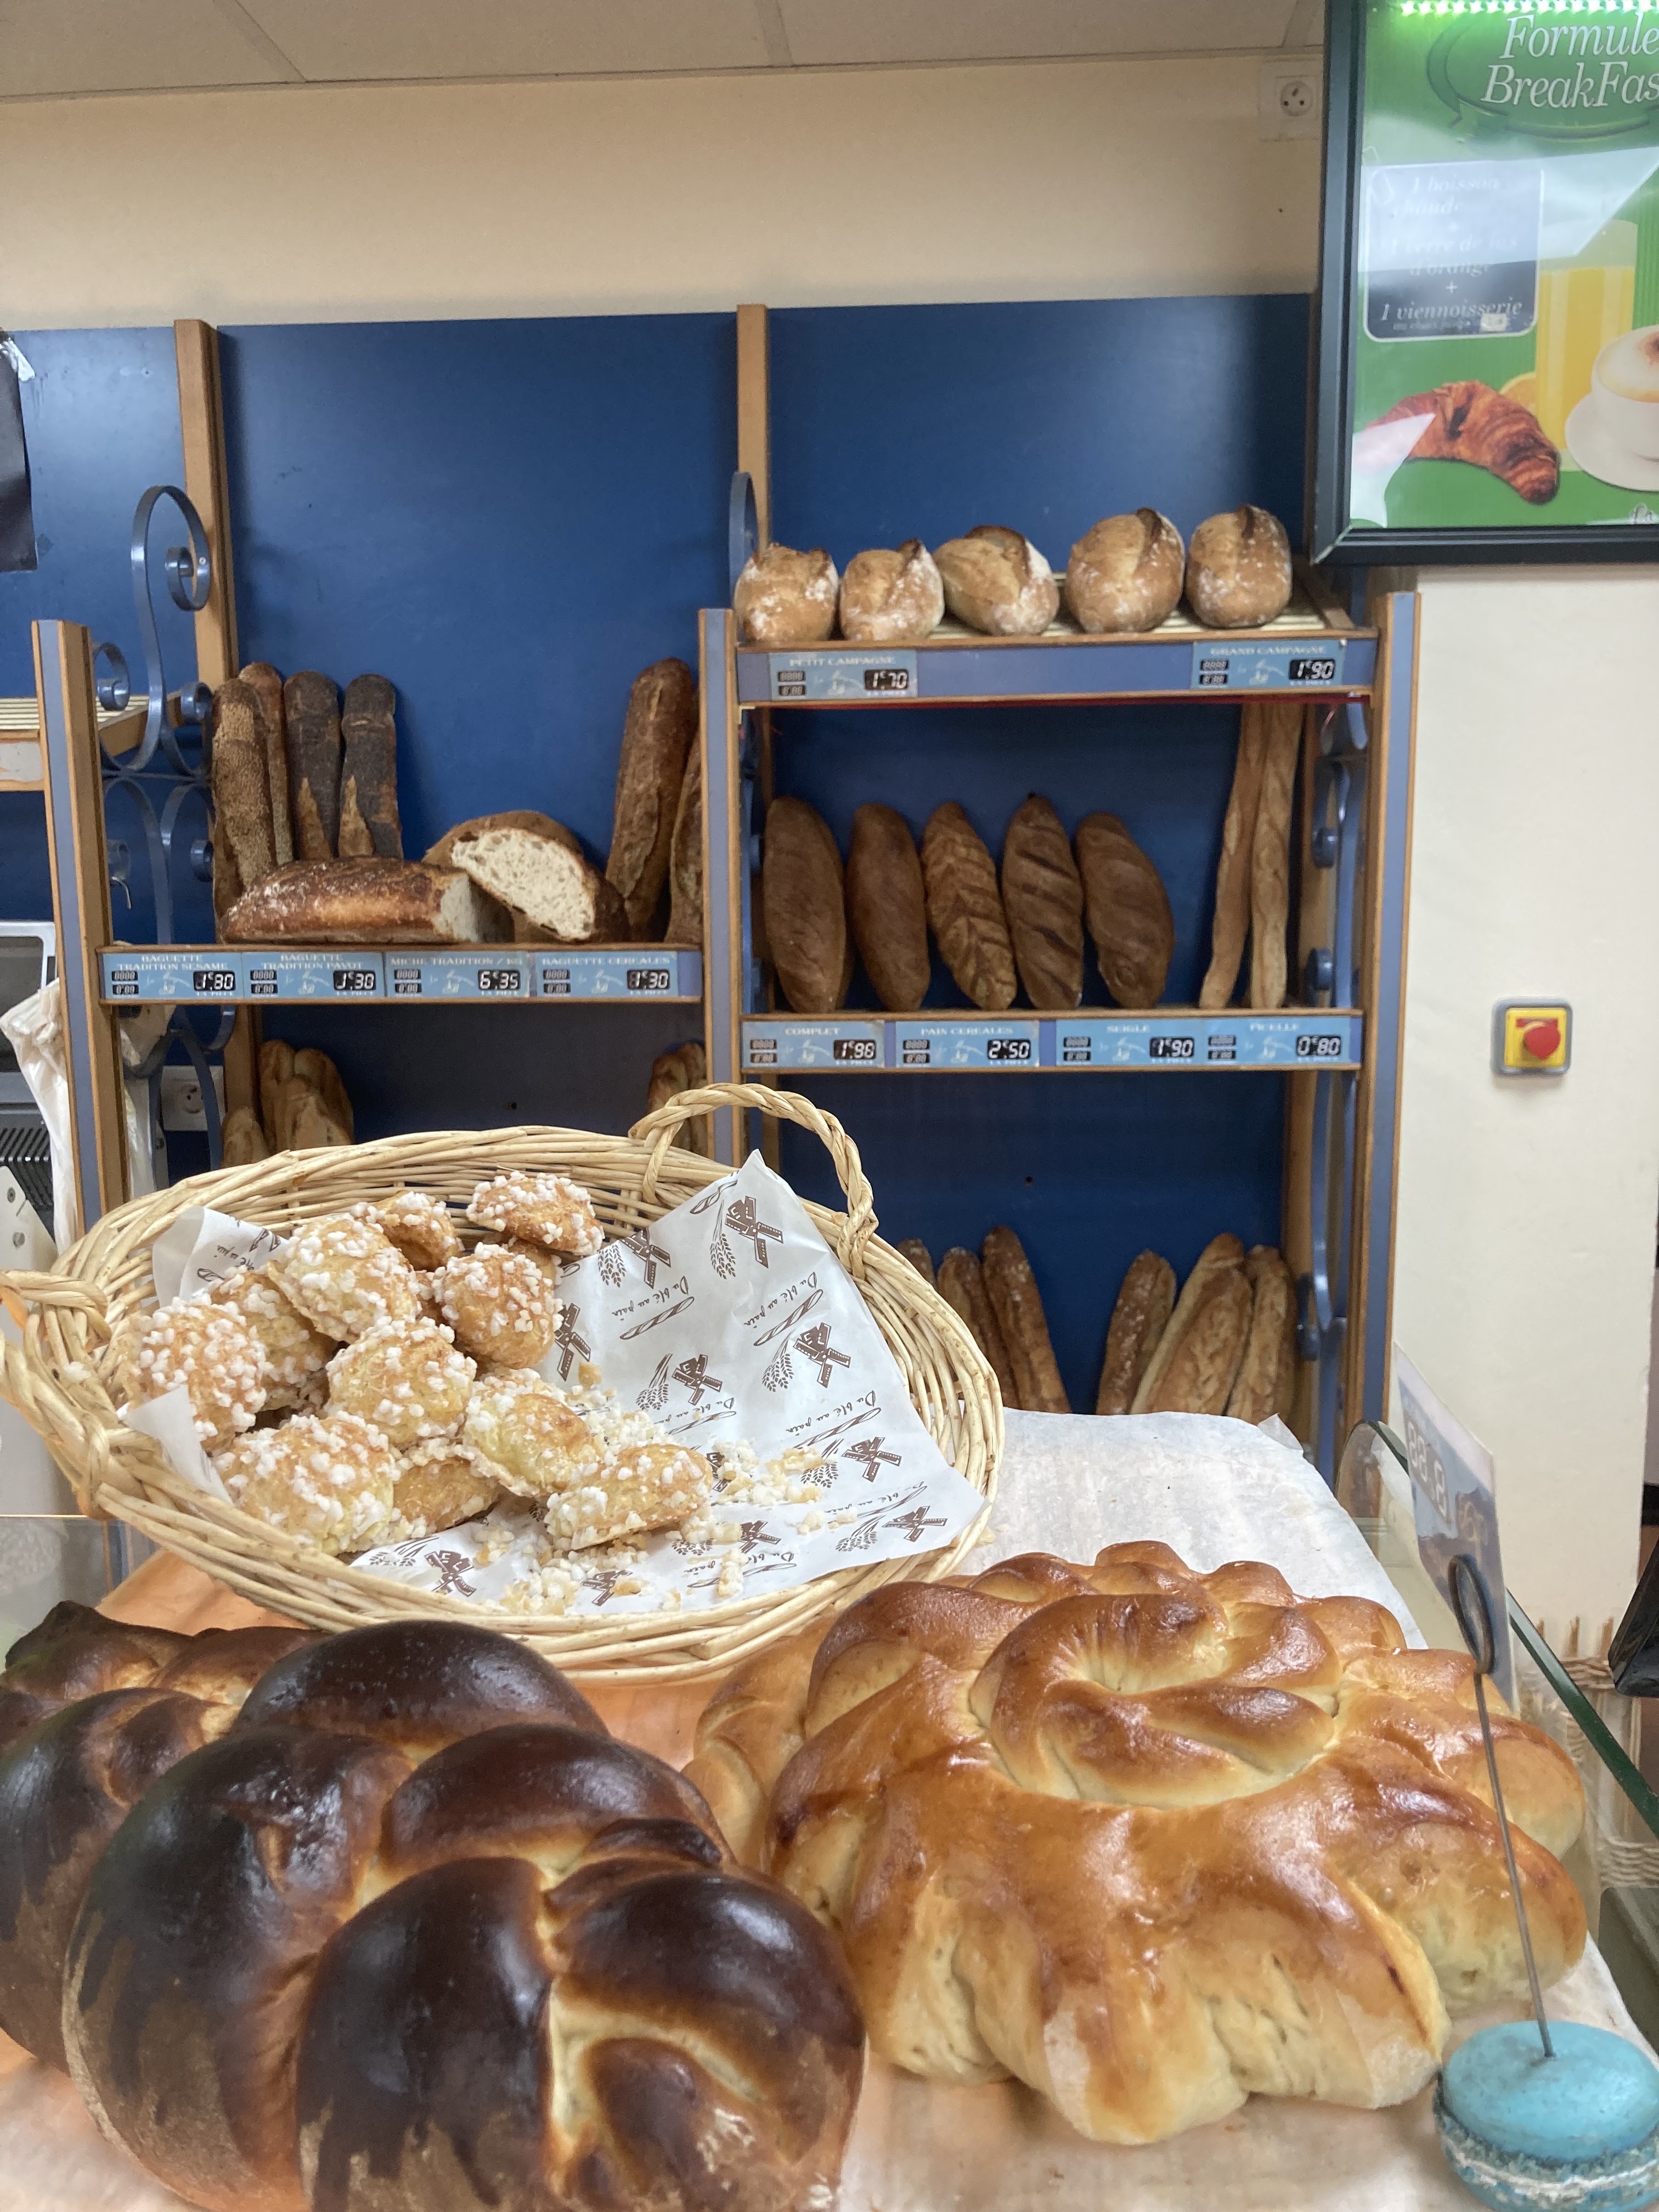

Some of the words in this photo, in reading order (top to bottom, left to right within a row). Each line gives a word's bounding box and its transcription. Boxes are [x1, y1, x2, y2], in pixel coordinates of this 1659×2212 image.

[1499, 11, 1659, 59] Formule
[141, 955, 202, 963] BAGUETTE
[281, 953, 343, 962] BAGUETTE
[431, 957, 493, 966] TRADITION
[117, 963, 178, 971] TRADITION
[261, 962, 323, 970] TRADITION
[785, 1027, 840, 1036] COMPLET
[921, 1027, 947, 1036] PAIN
[673, 1276, 689, 1295] Du
[800, 1272, 817, 1289] Du
[653, 1288, 670, 1304] blé
[780, 1285, 798, 1303] blé
[637, 1299, 650, 1307] au
[768, 1299, 778, 1310] au
[612, 1300, 634, 1321] pain
[744, 1306, 765, 1328] pain
[715, 1397, 735, 1409] Du
[856, 1390, 876, 1407] Du
[833, 1402, 853, 1417] blé
[786, 1417, 812, 1436] pain
[770, 1552, 794, 1562] Du
